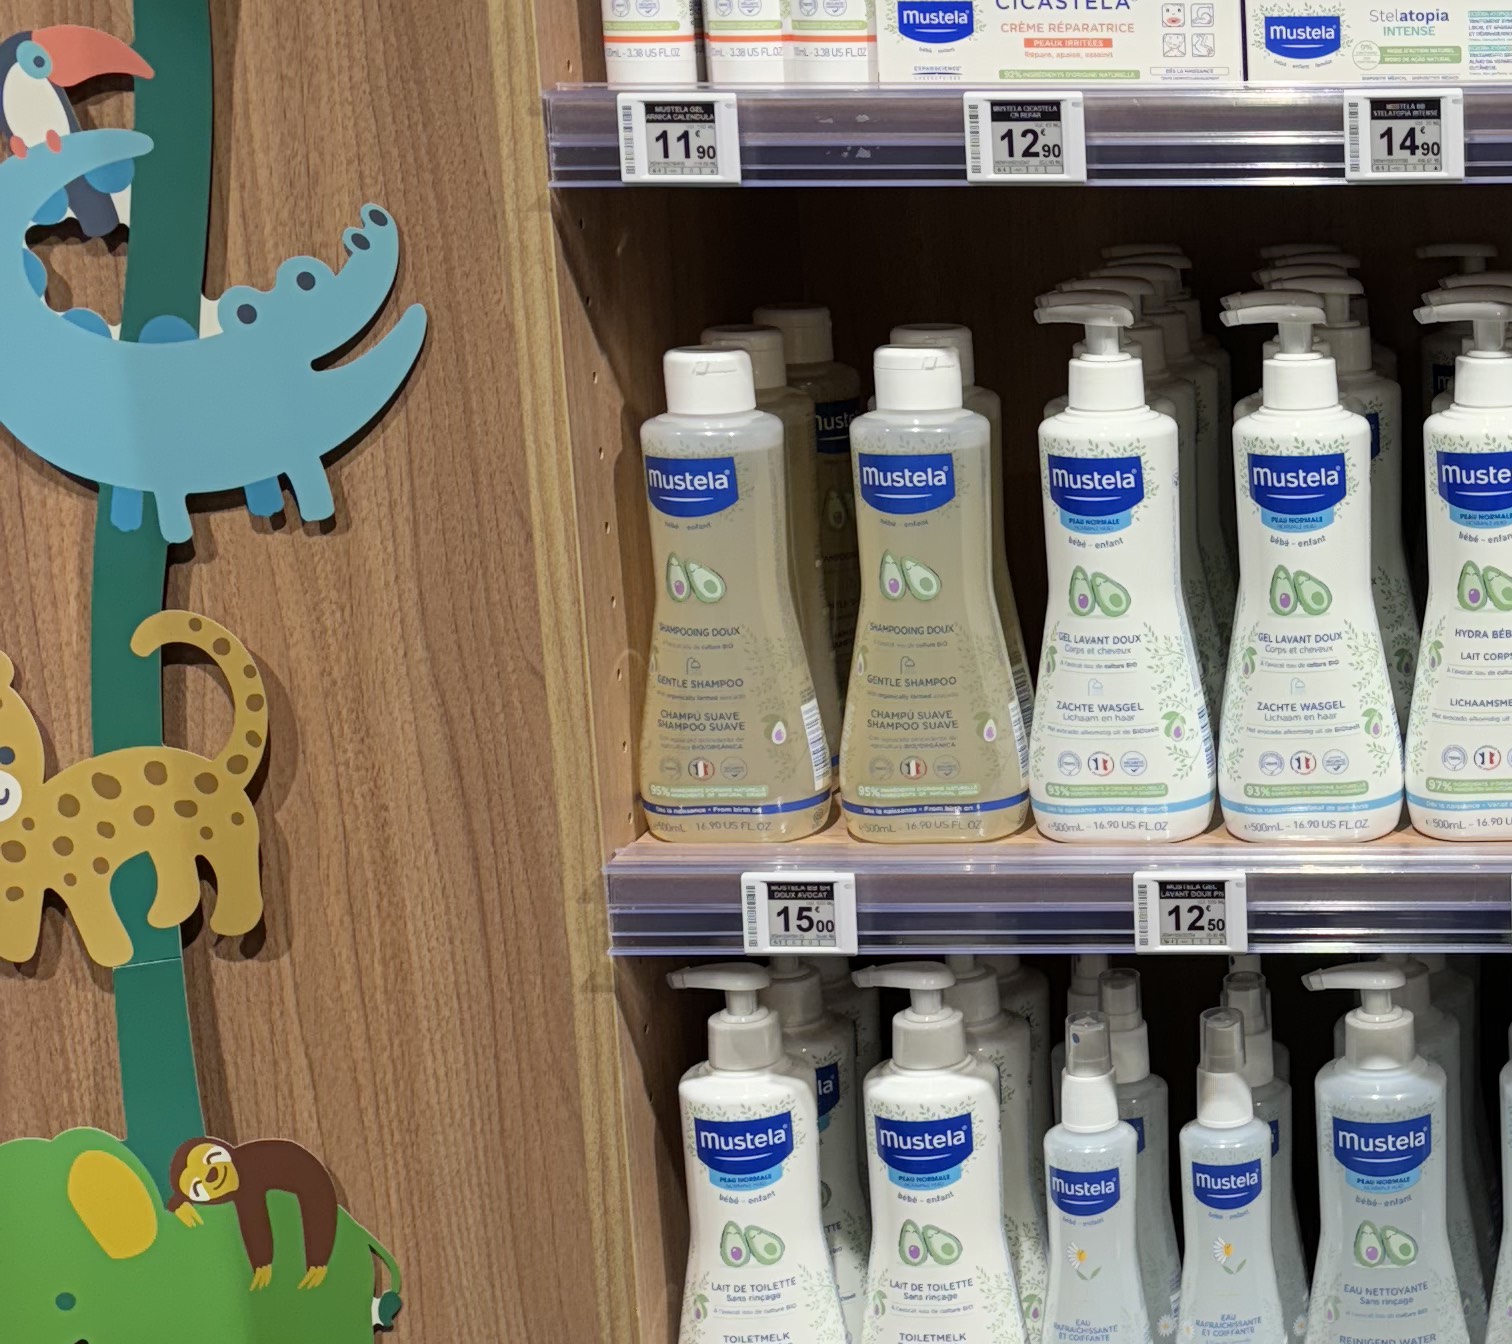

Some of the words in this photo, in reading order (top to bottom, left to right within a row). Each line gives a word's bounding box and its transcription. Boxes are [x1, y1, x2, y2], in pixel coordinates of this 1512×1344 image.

[903, 8, 969, 27] Mustela
[1455, 628, 1488, 639] HYDRA
[711, 1282, 731, 1293] LAIT
[733, 1283, 747, 1293] DE
[750, 1277, 796, 1292] TOILETTE
[723, 1332, 790, 1344] TOILETMELK
